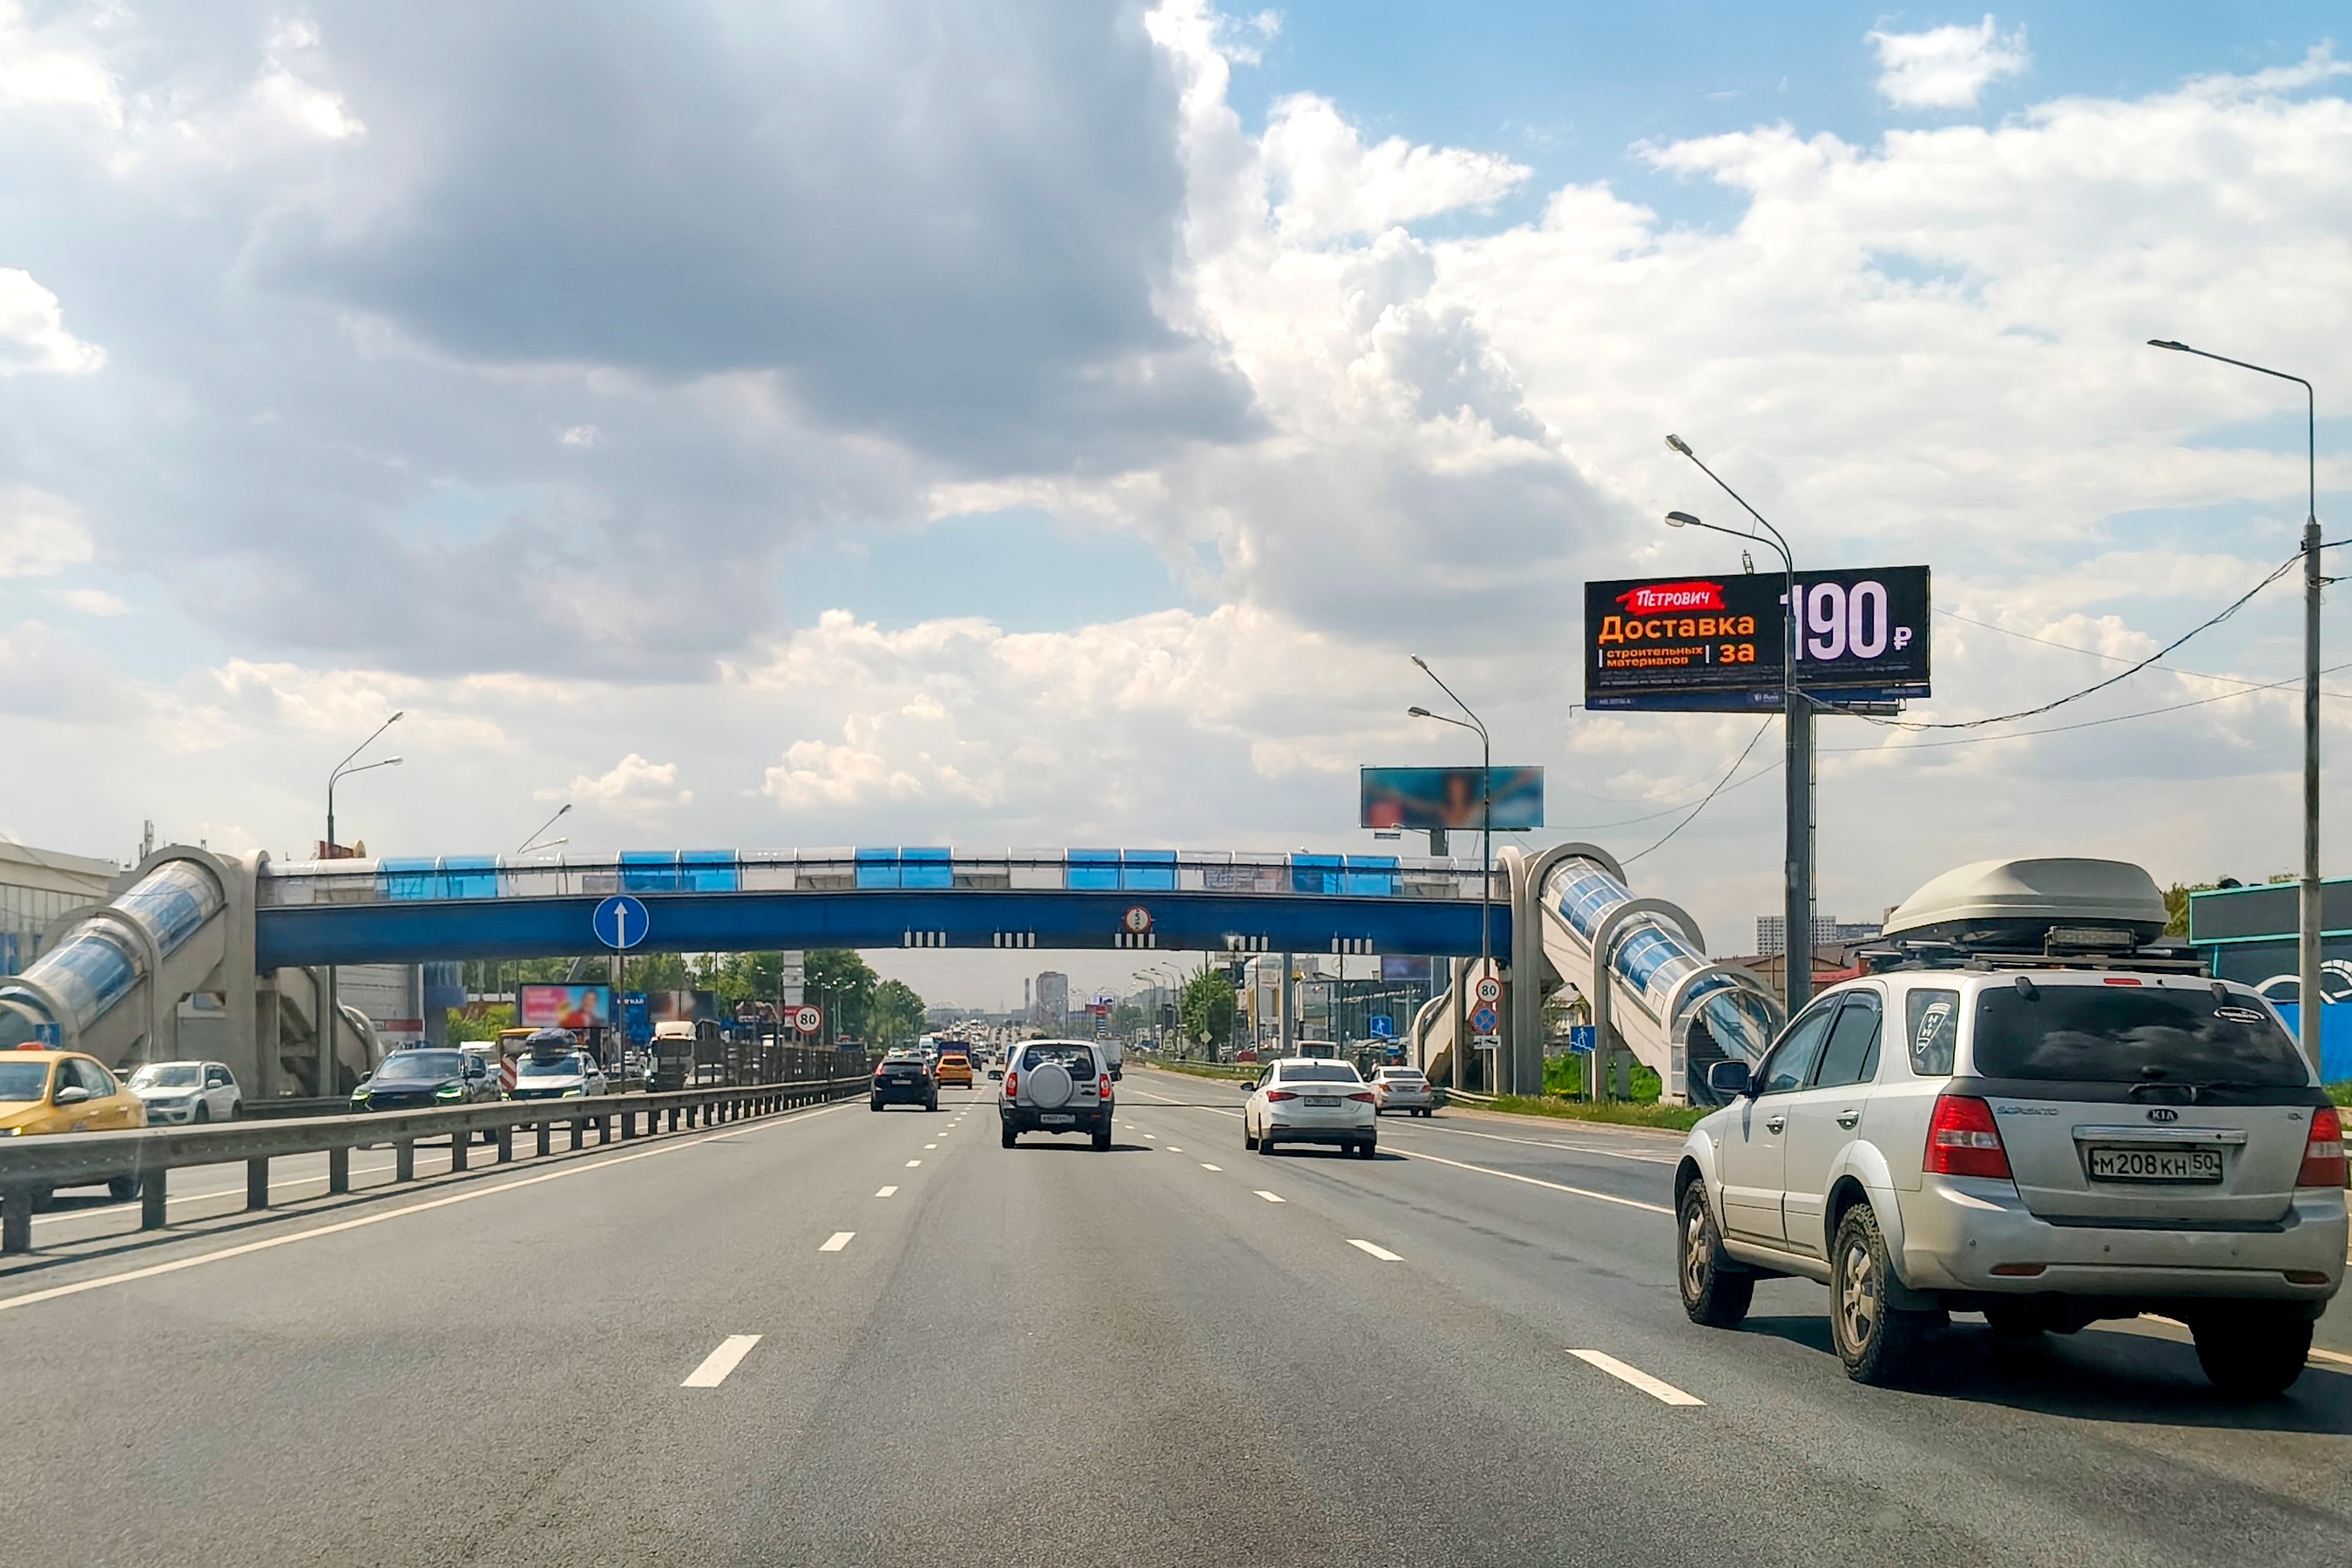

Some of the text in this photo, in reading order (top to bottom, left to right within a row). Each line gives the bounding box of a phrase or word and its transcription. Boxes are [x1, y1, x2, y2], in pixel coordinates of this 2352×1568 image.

[1780, 581, 1888, 660] 190
[1598, 615, 1755, 645] Доставка
[1606, 643, 1754, 663] строительных за
[1606, 657, 1689, 667] материалов
[1482, 984, 1497, 996] 80
[800, 1013, 816, 1025] 80
[2152, 1110, 2174, 1119] KIA
[2099, 1154, 2213, 1175] М208КН 50
